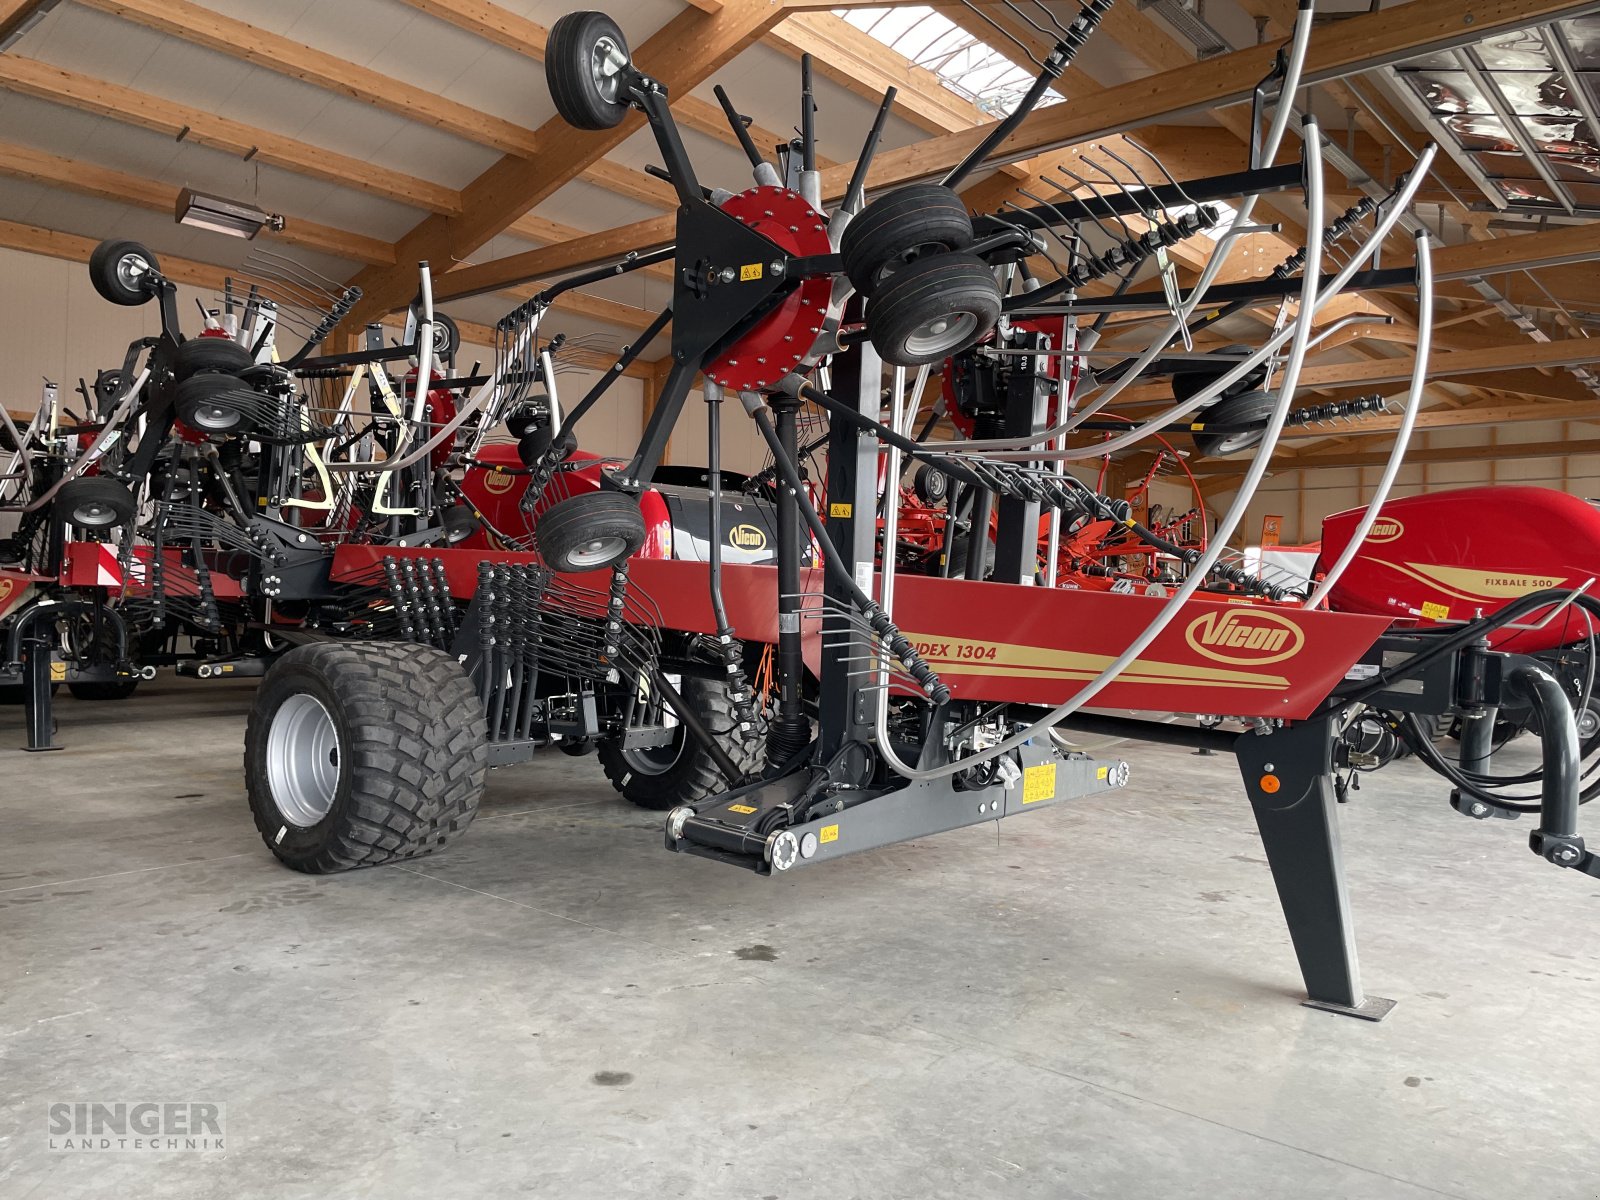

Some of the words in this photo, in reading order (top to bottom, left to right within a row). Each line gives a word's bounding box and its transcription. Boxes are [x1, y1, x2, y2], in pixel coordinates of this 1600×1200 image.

[1368, 521, 1398, 536] icon
[1485, 578, 1527, 587] FIXBALE
[1531, 579, 1553, 588] 500
[1200, 609, 1291, 653] Vicon
[956, 645, 997, 660] 1304
